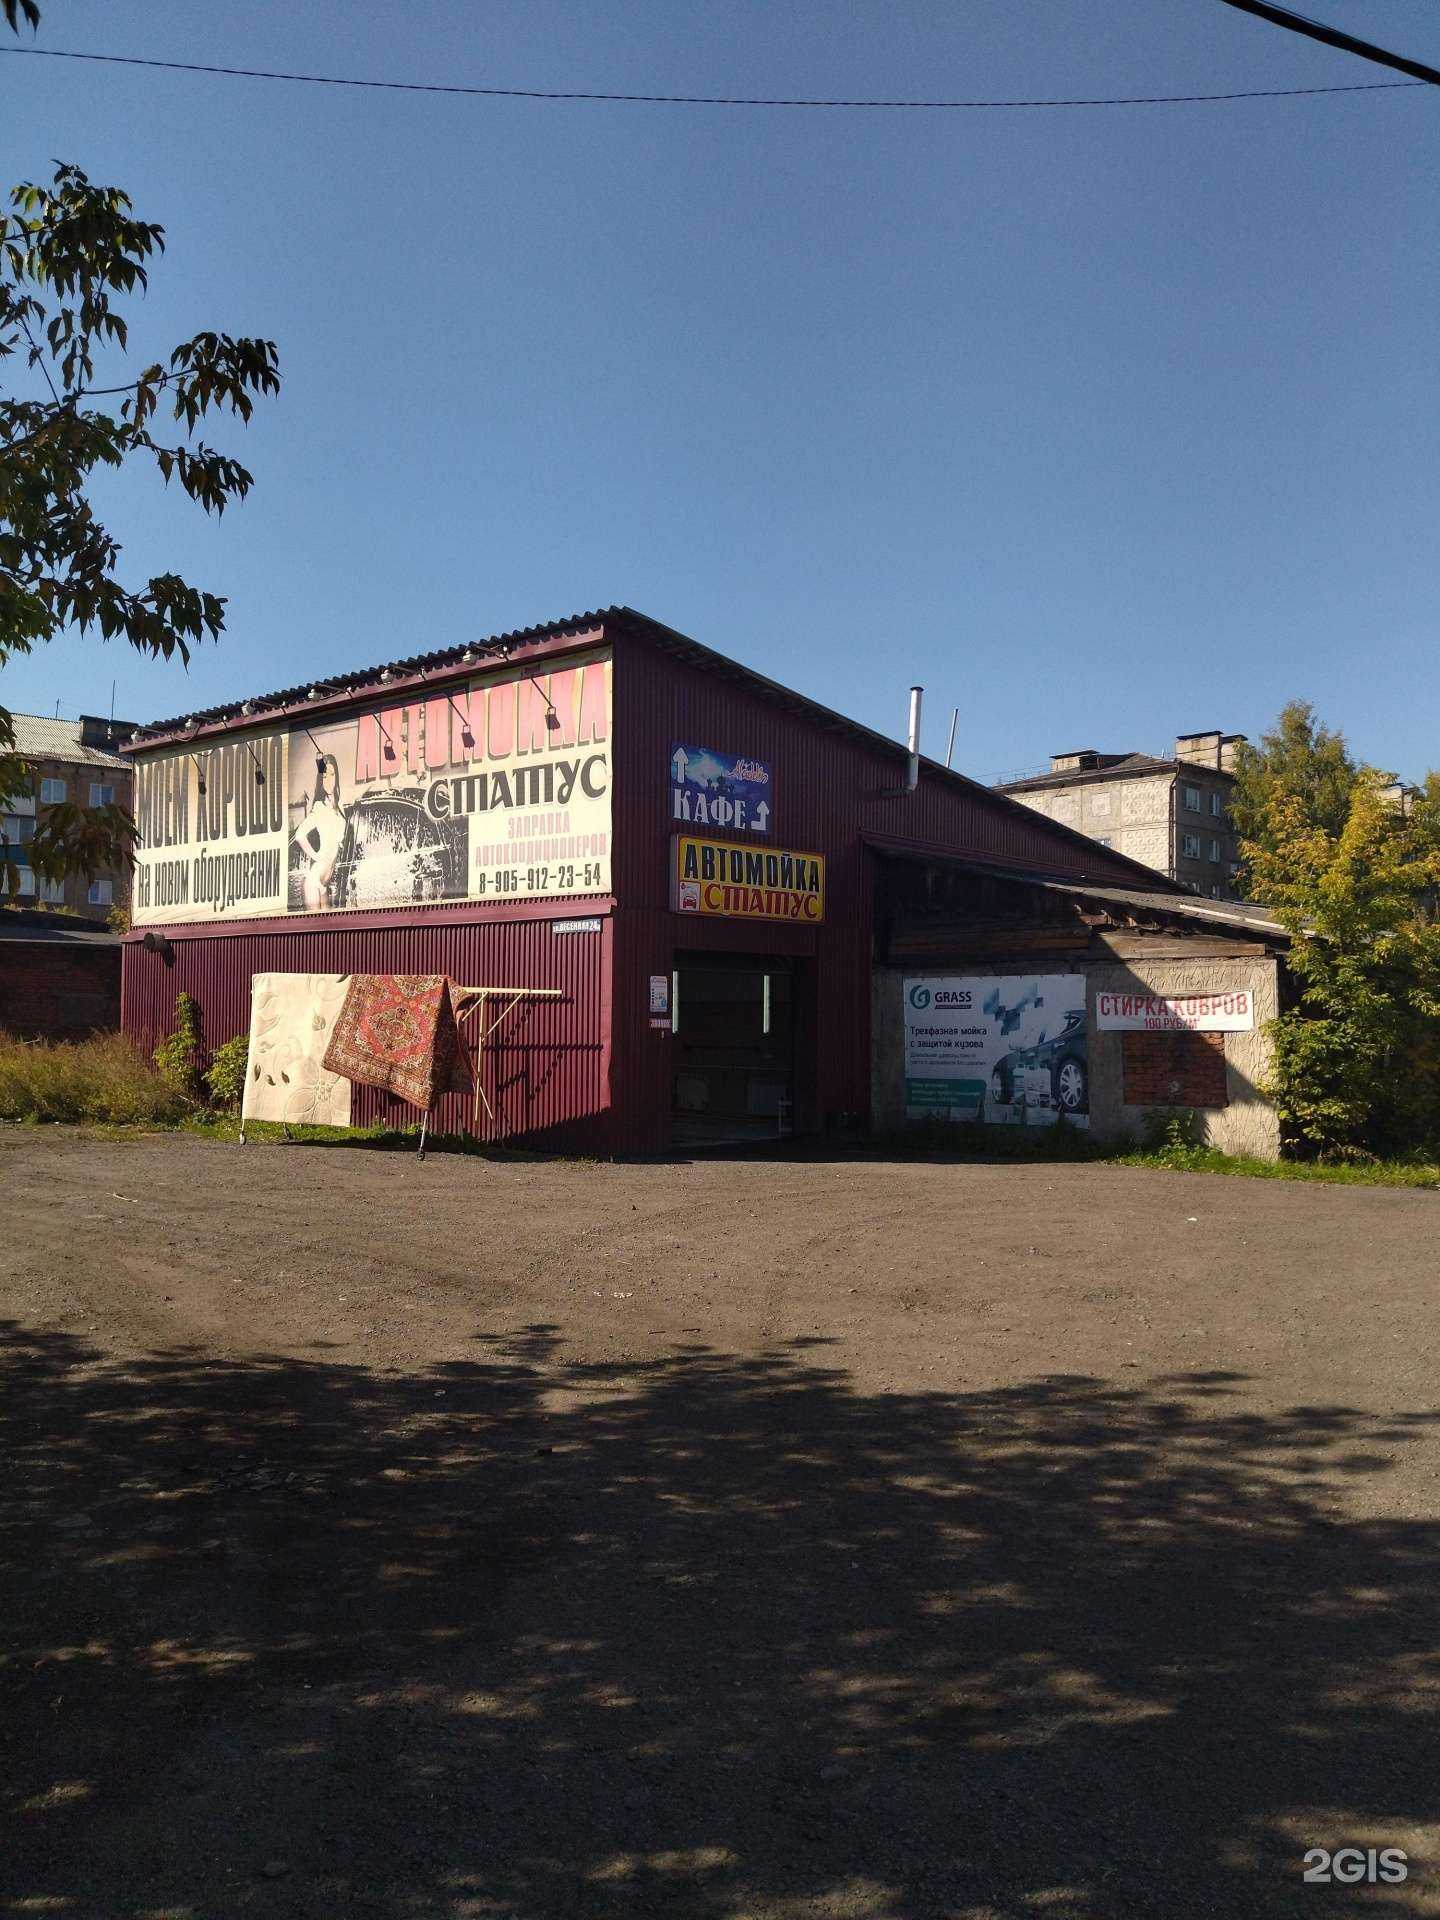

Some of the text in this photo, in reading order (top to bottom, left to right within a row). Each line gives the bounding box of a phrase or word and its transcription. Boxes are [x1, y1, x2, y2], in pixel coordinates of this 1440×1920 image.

[355, 661, 607, 784] АВТОМОЙКА
[137, 735, 283, 850] МОЕМ ХОРОШО
[426, 753, 608, 821] СТАТУС
[508, 811, 571, 839] ЗАПРАВКА
[672, 788, 747, 830] КАФЕ
[475, 832, 607, 867] АВТОКОНДИЦИОНЕРОВ
[138, 847, 281, 913] на новом оборудовании
[479, 863, 601, 894] 8-905-912-23-54
[684, 844, 820, 893] АВТОМОЙКА
[704, 883, 818, 919] СТАТУС
[934, 991, 972, 1003] GRASS
[1100, 993, 1249, 1017] СТИРКА КОВРОВ
[911, 1025, 988, 1037] Трехфазная мойка
[917, 1039, 952, 1049] защитой
[954, 1041, 984, 1050] кузова
